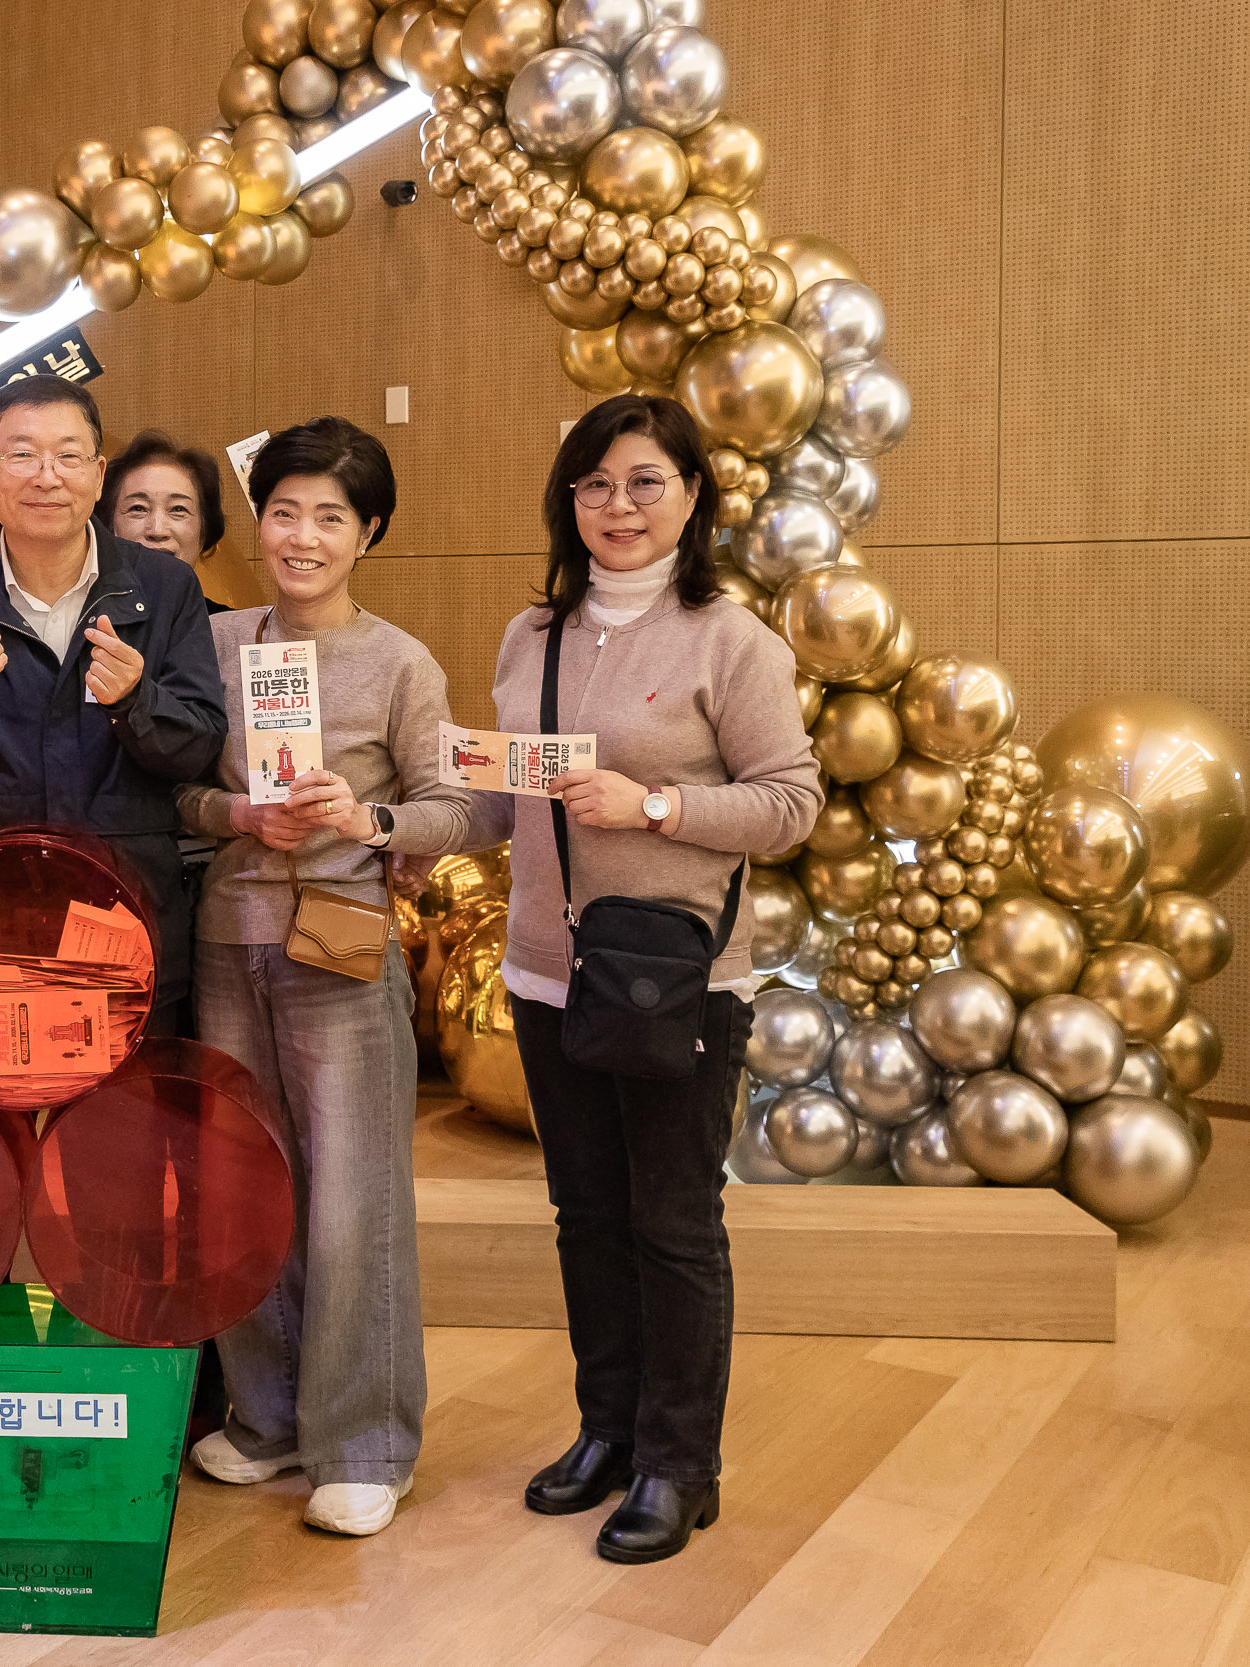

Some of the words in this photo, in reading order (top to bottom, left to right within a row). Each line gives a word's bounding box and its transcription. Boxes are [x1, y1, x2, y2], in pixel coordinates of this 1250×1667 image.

[43, 340, 91, 384] 날
[251, 670, 272, 679] 2026
[251, 677, 309, 697] 따뜻한
[253, 696, 309, 711] 겨울나기
[561, 744, 569, 764] 2026
[528, 743, 540, 789] 겨울나기
